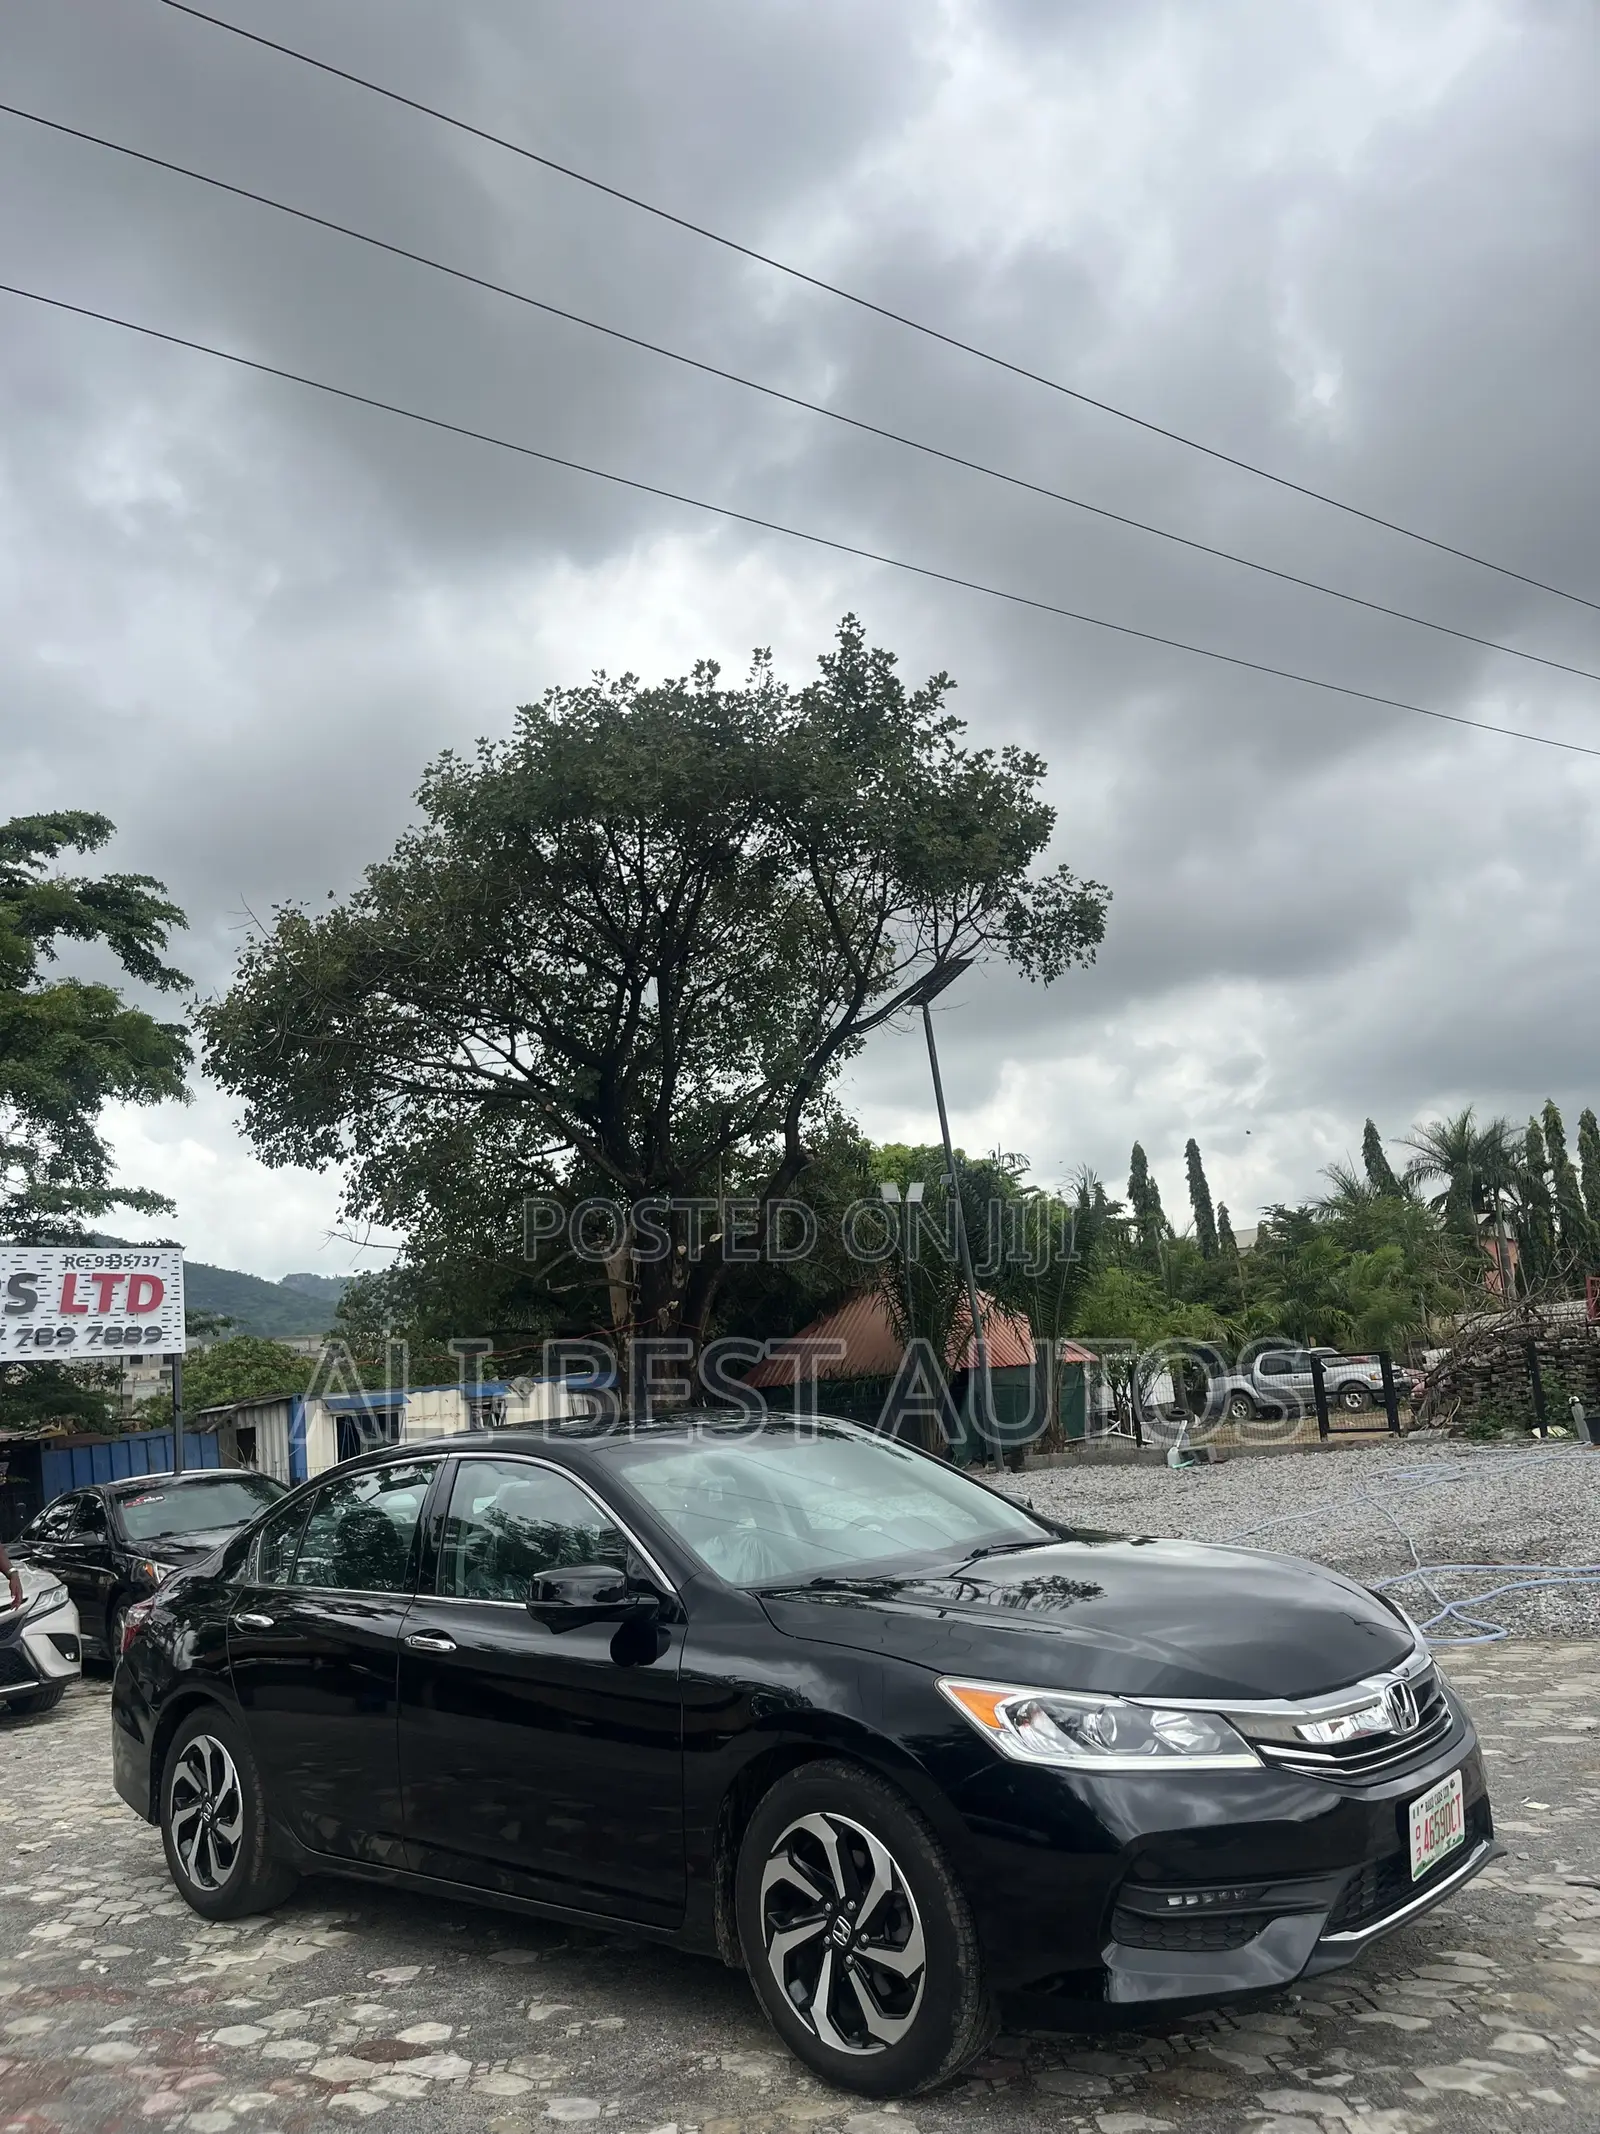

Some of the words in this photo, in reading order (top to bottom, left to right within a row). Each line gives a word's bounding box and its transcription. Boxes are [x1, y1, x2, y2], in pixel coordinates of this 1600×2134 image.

[0, 1272, 39, 1315] S
[58, 1272, 165, 1315] LTD
[84, 1325, 163, 1346] 7889
